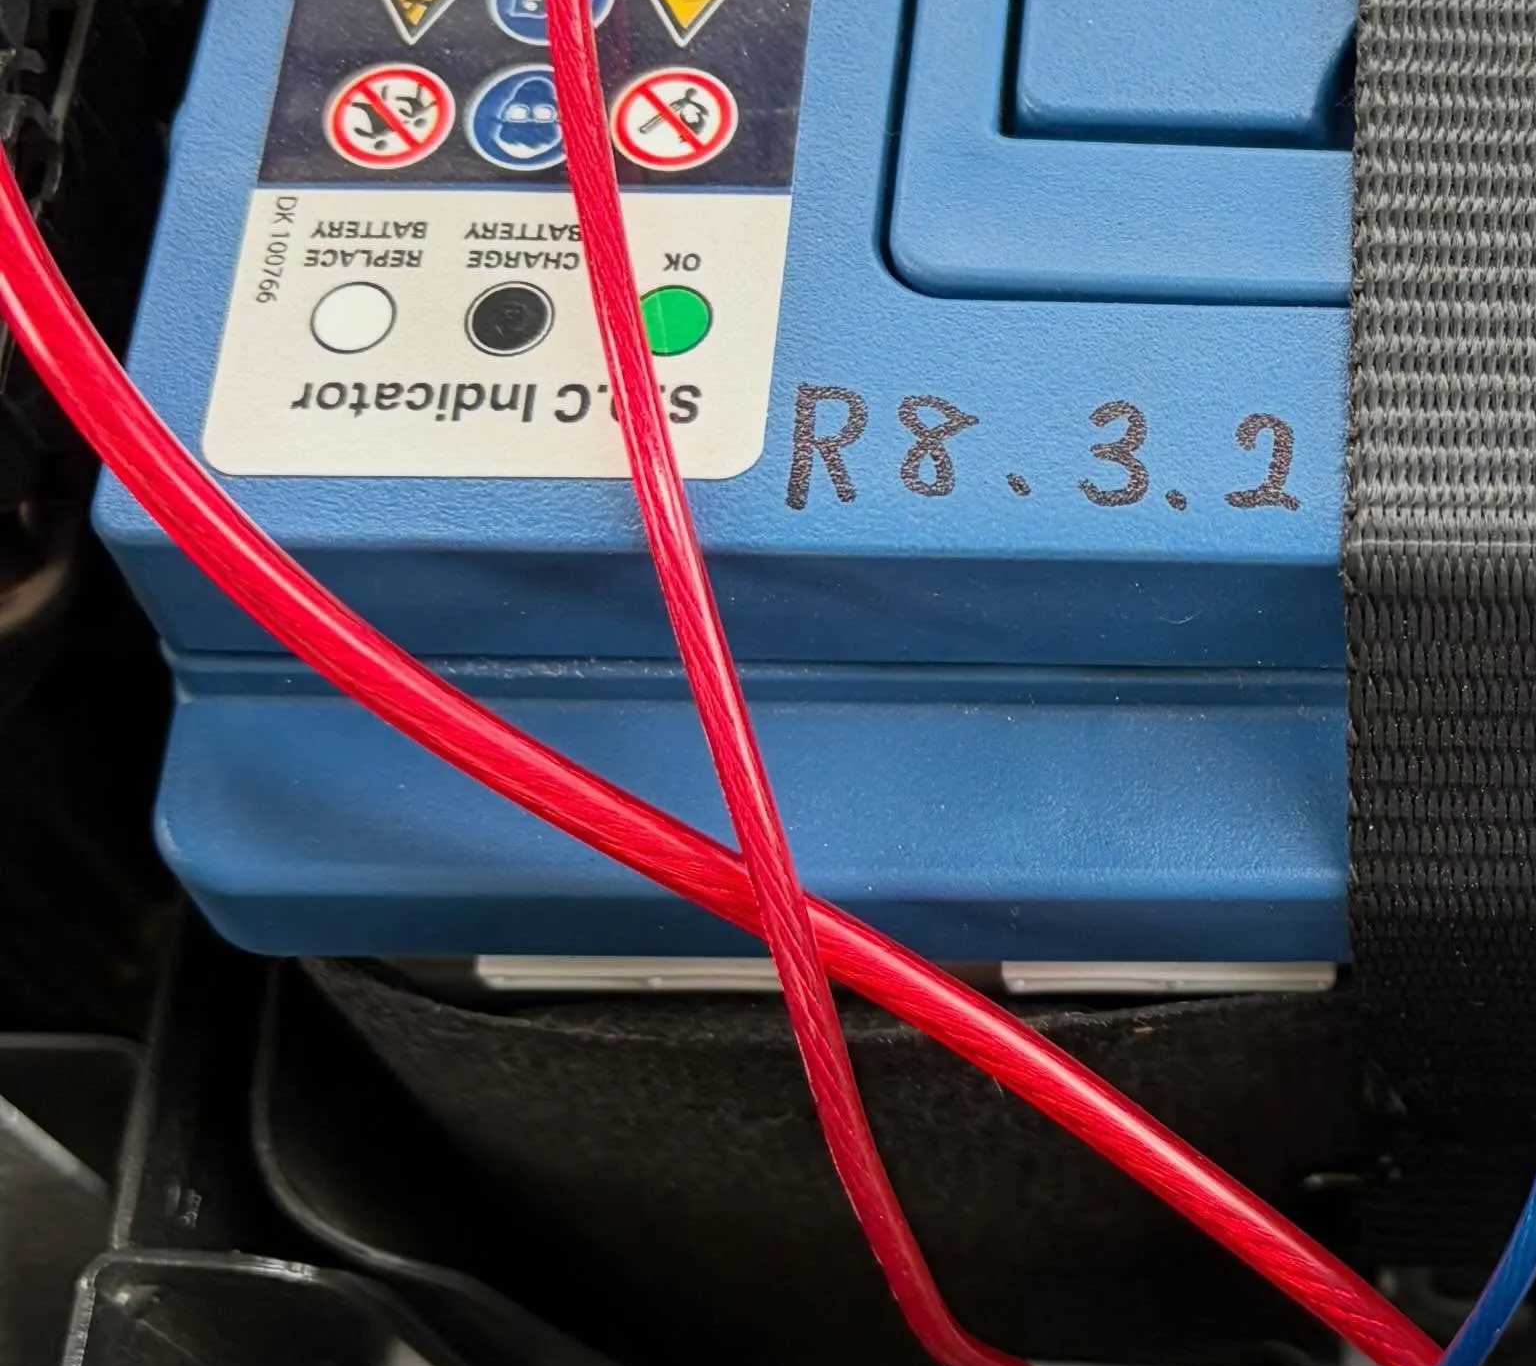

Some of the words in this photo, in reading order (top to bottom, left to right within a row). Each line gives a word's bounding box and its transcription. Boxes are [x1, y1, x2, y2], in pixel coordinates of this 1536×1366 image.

[273, 195, 299, 226] DK
[311, 220, 429, 241] BATTERY
[464, 221, 584, 242] BATTERY
[255, 231, 290, 305] 100766
[303, 248, 424, 269] REPLACE
[466, 249, 581, 271] CHARGE
[663, 252, 702, 273] OK
[290, 380, 536, 425] Indicator
